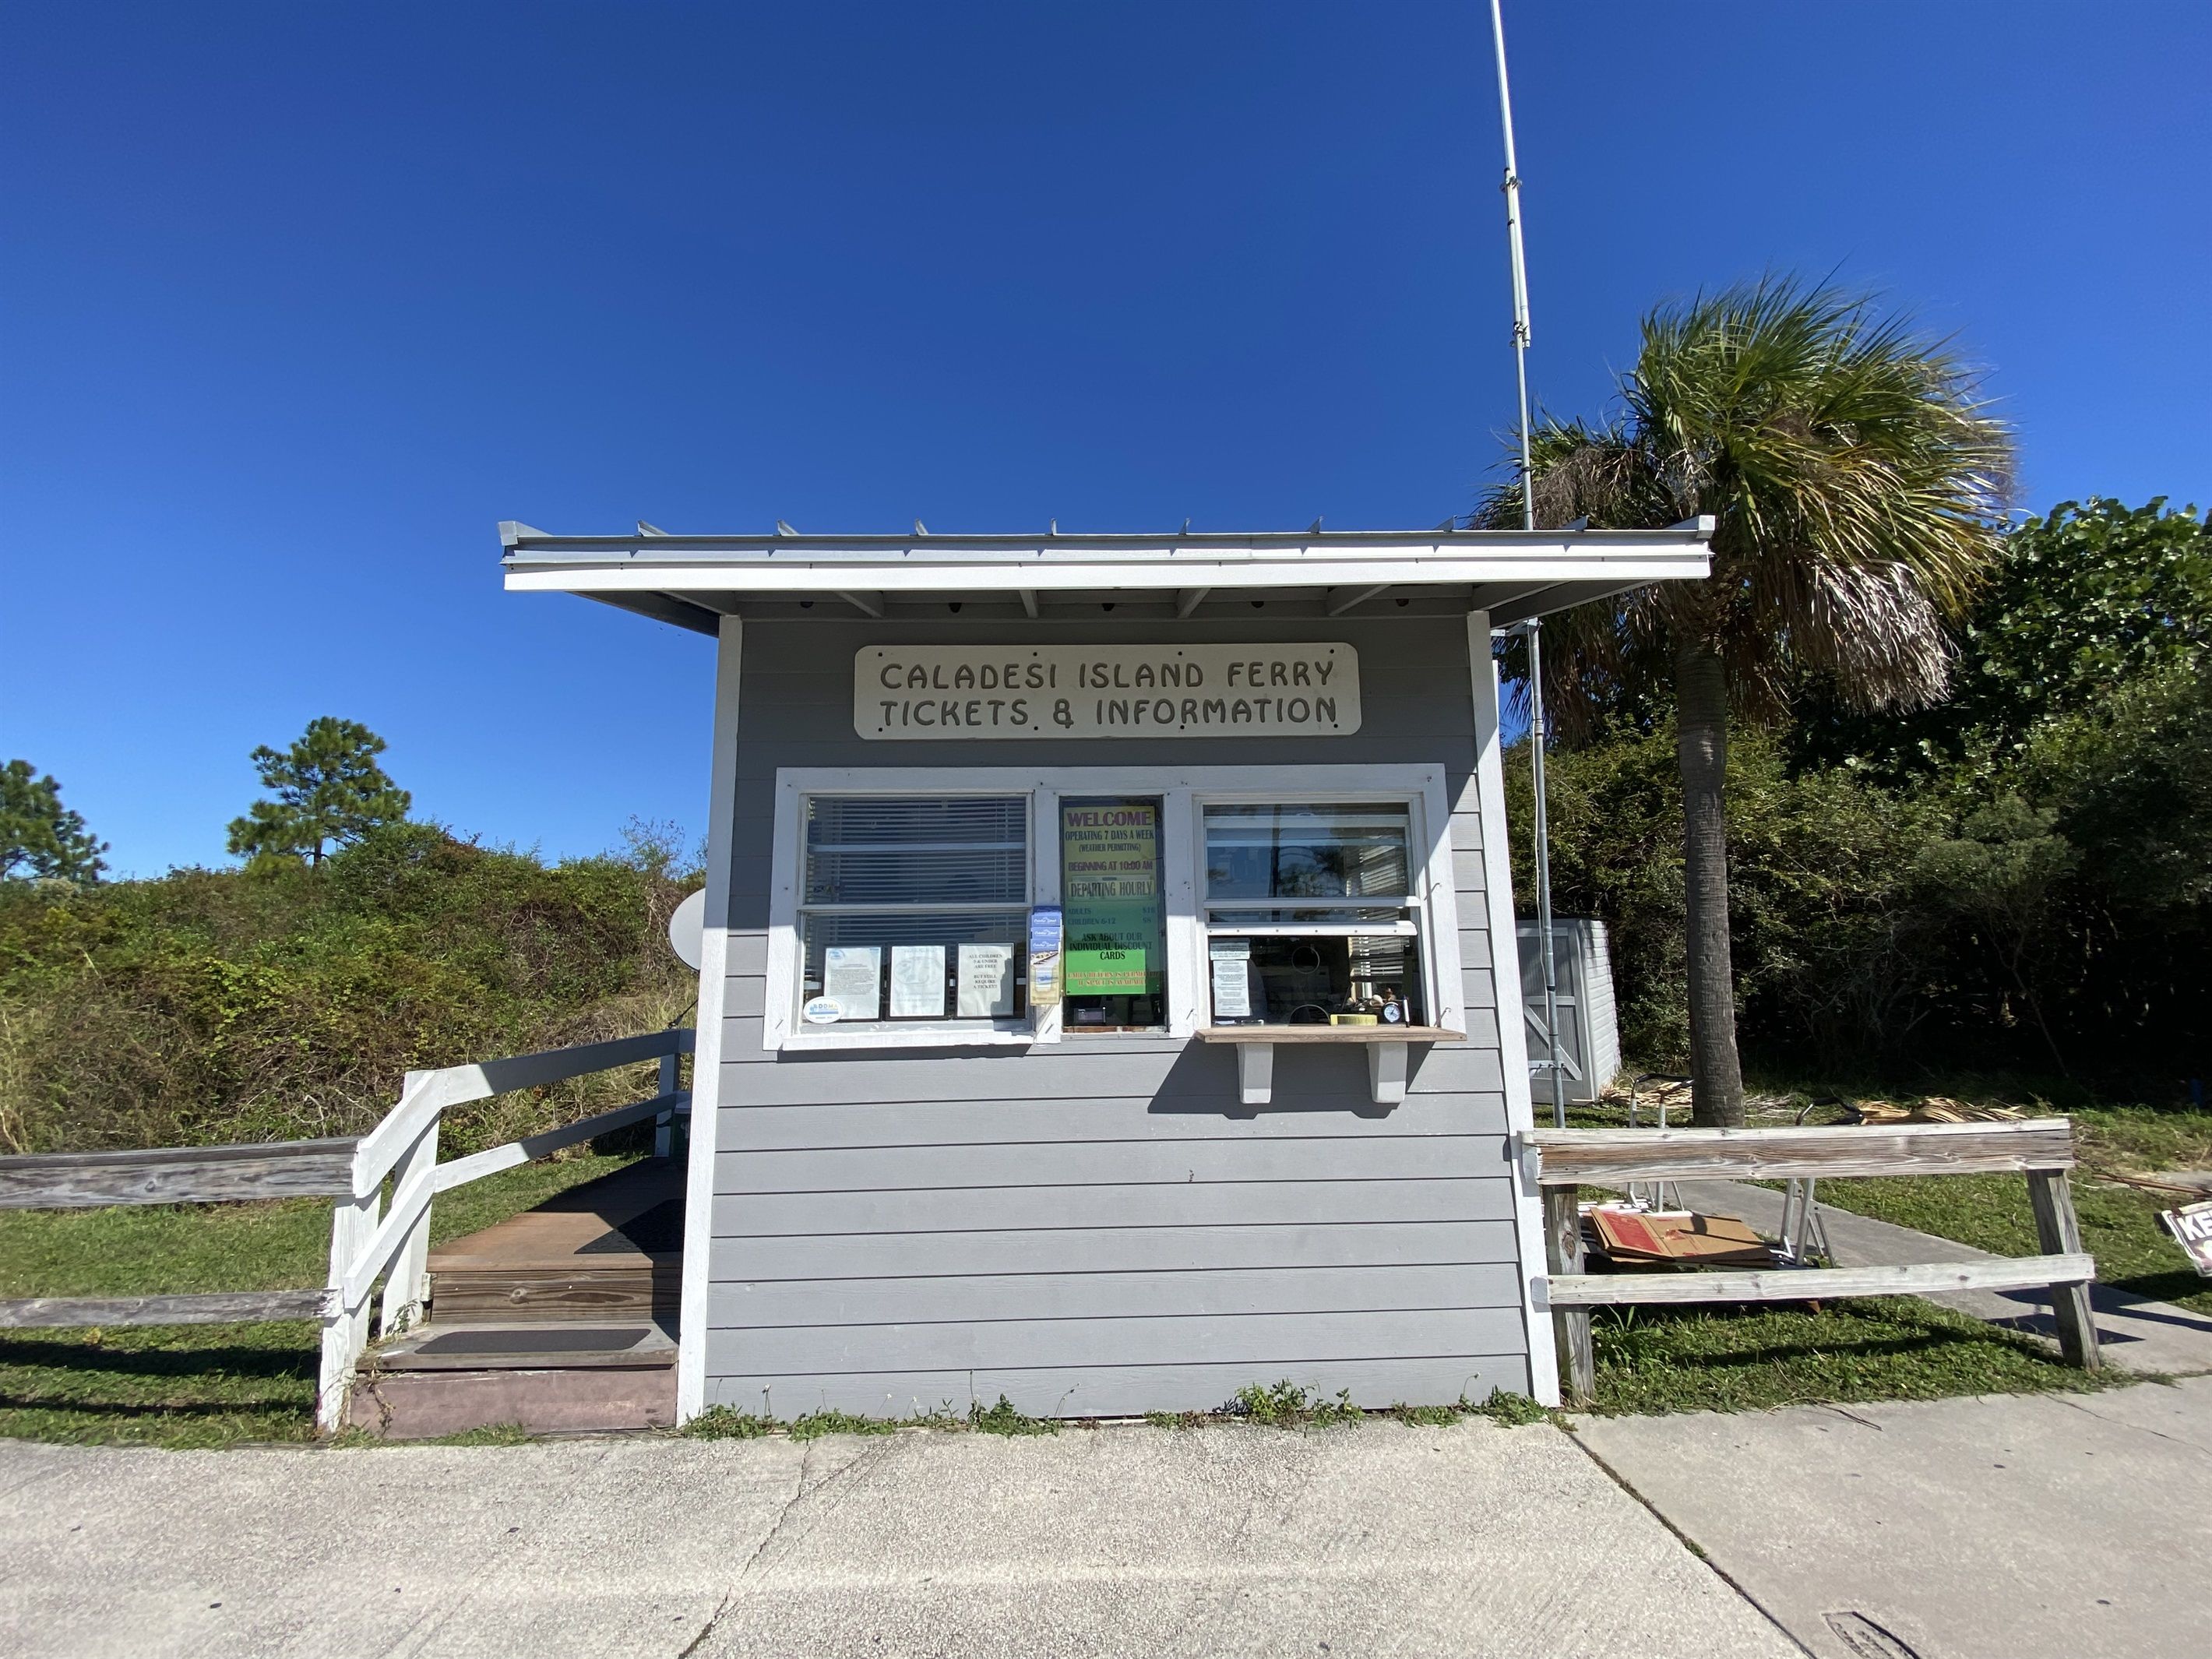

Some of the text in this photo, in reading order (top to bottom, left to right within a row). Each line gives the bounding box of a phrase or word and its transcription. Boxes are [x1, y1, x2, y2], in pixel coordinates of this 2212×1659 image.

[880, 660, 1333, 689] CALADESI ISLAND FERRY
[879, 697, 1337, 729] TICKETS & INFORMATION
[1067, 812, 1152, 826] WELCOME
[1065, 830, 1154, 840] OPERATING 7 DAYS A WEEK
[1079, 843, 1141, 853] (WEATHER PERMITTING)
[1068, 860, 1153, 872] BEGINNING AT 10:00 AM
[1071, 881, 1153, 897] DEPARTING HOURLY
[1082, 932, 1143, 942] ASK ABOUT OUR
[1069, 941, 1153, 951] INDIVIDUAL DISCOUNT
[1100, 951, 1125, 960] CARDS
[2177, 1210, 2212, 1241] KE
